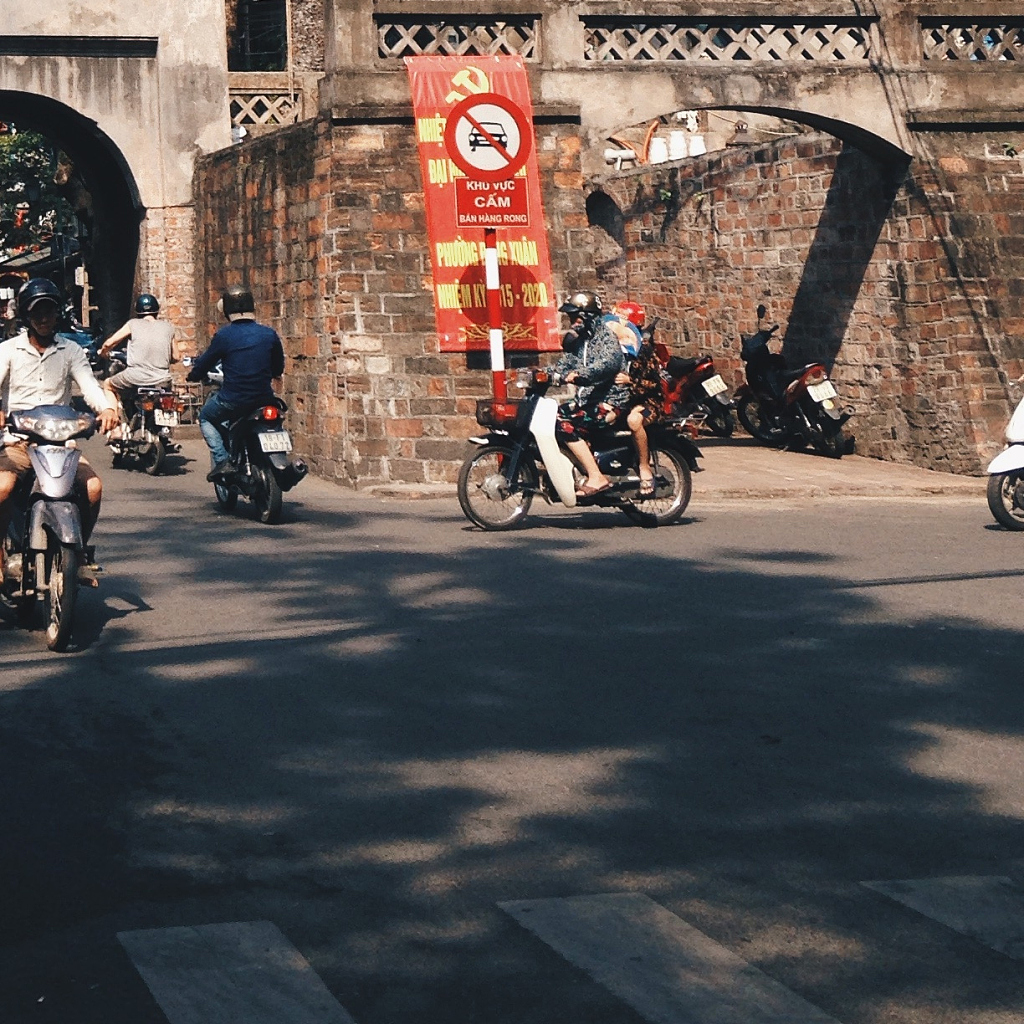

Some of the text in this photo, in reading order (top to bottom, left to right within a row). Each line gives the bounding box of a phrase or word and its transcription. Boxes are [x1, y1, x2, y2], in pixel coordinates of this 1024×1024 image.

[428, 159, 448, 188] ĐẠI
[466, 180, 515, 193] KHU VỰC
[474, 193, 511, 208] CẤM
[459, 212, 527, 223] BÁN HÀNG RONG
[436, 235, 479, 267] PHƯỜNG
[509, 235, 539, 266] XUÂN
[437, 278, 472, 315] NHIỆM
[521, 282, 548, 308] 2020
